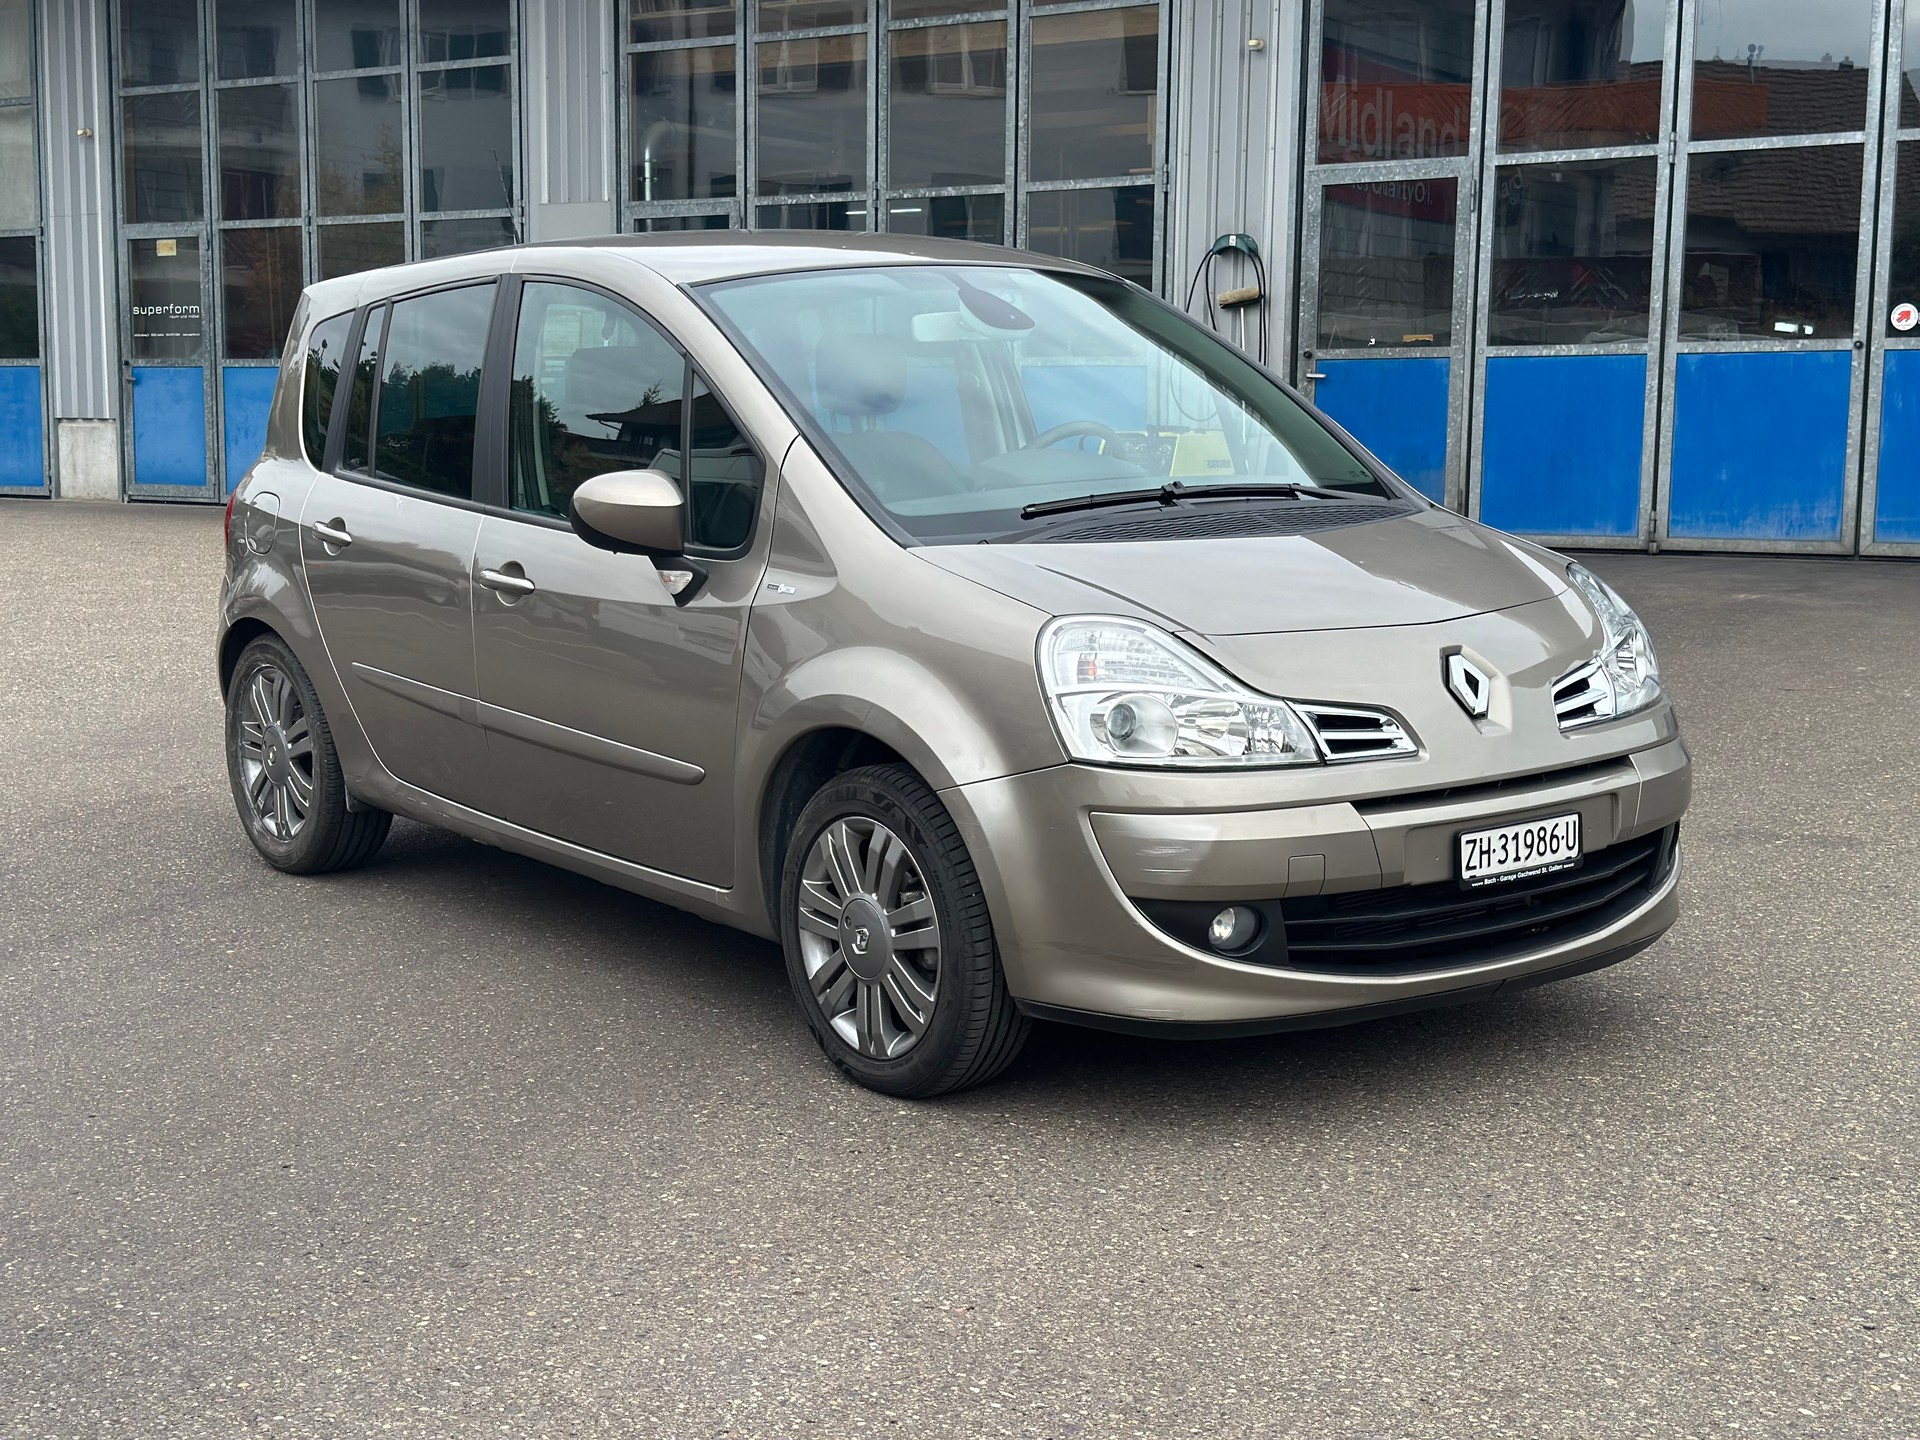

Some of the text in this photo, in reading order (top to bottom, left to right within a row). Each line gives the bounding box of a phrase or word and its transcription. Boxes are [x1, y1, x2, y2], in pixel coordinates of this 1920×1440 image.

[1321, 72, 1461, 160] Midland
[133, 303, 200, 316] superform
[1499, 874, 1517, 882] Garage
[1548, 864, 1563, 872] Gallen
